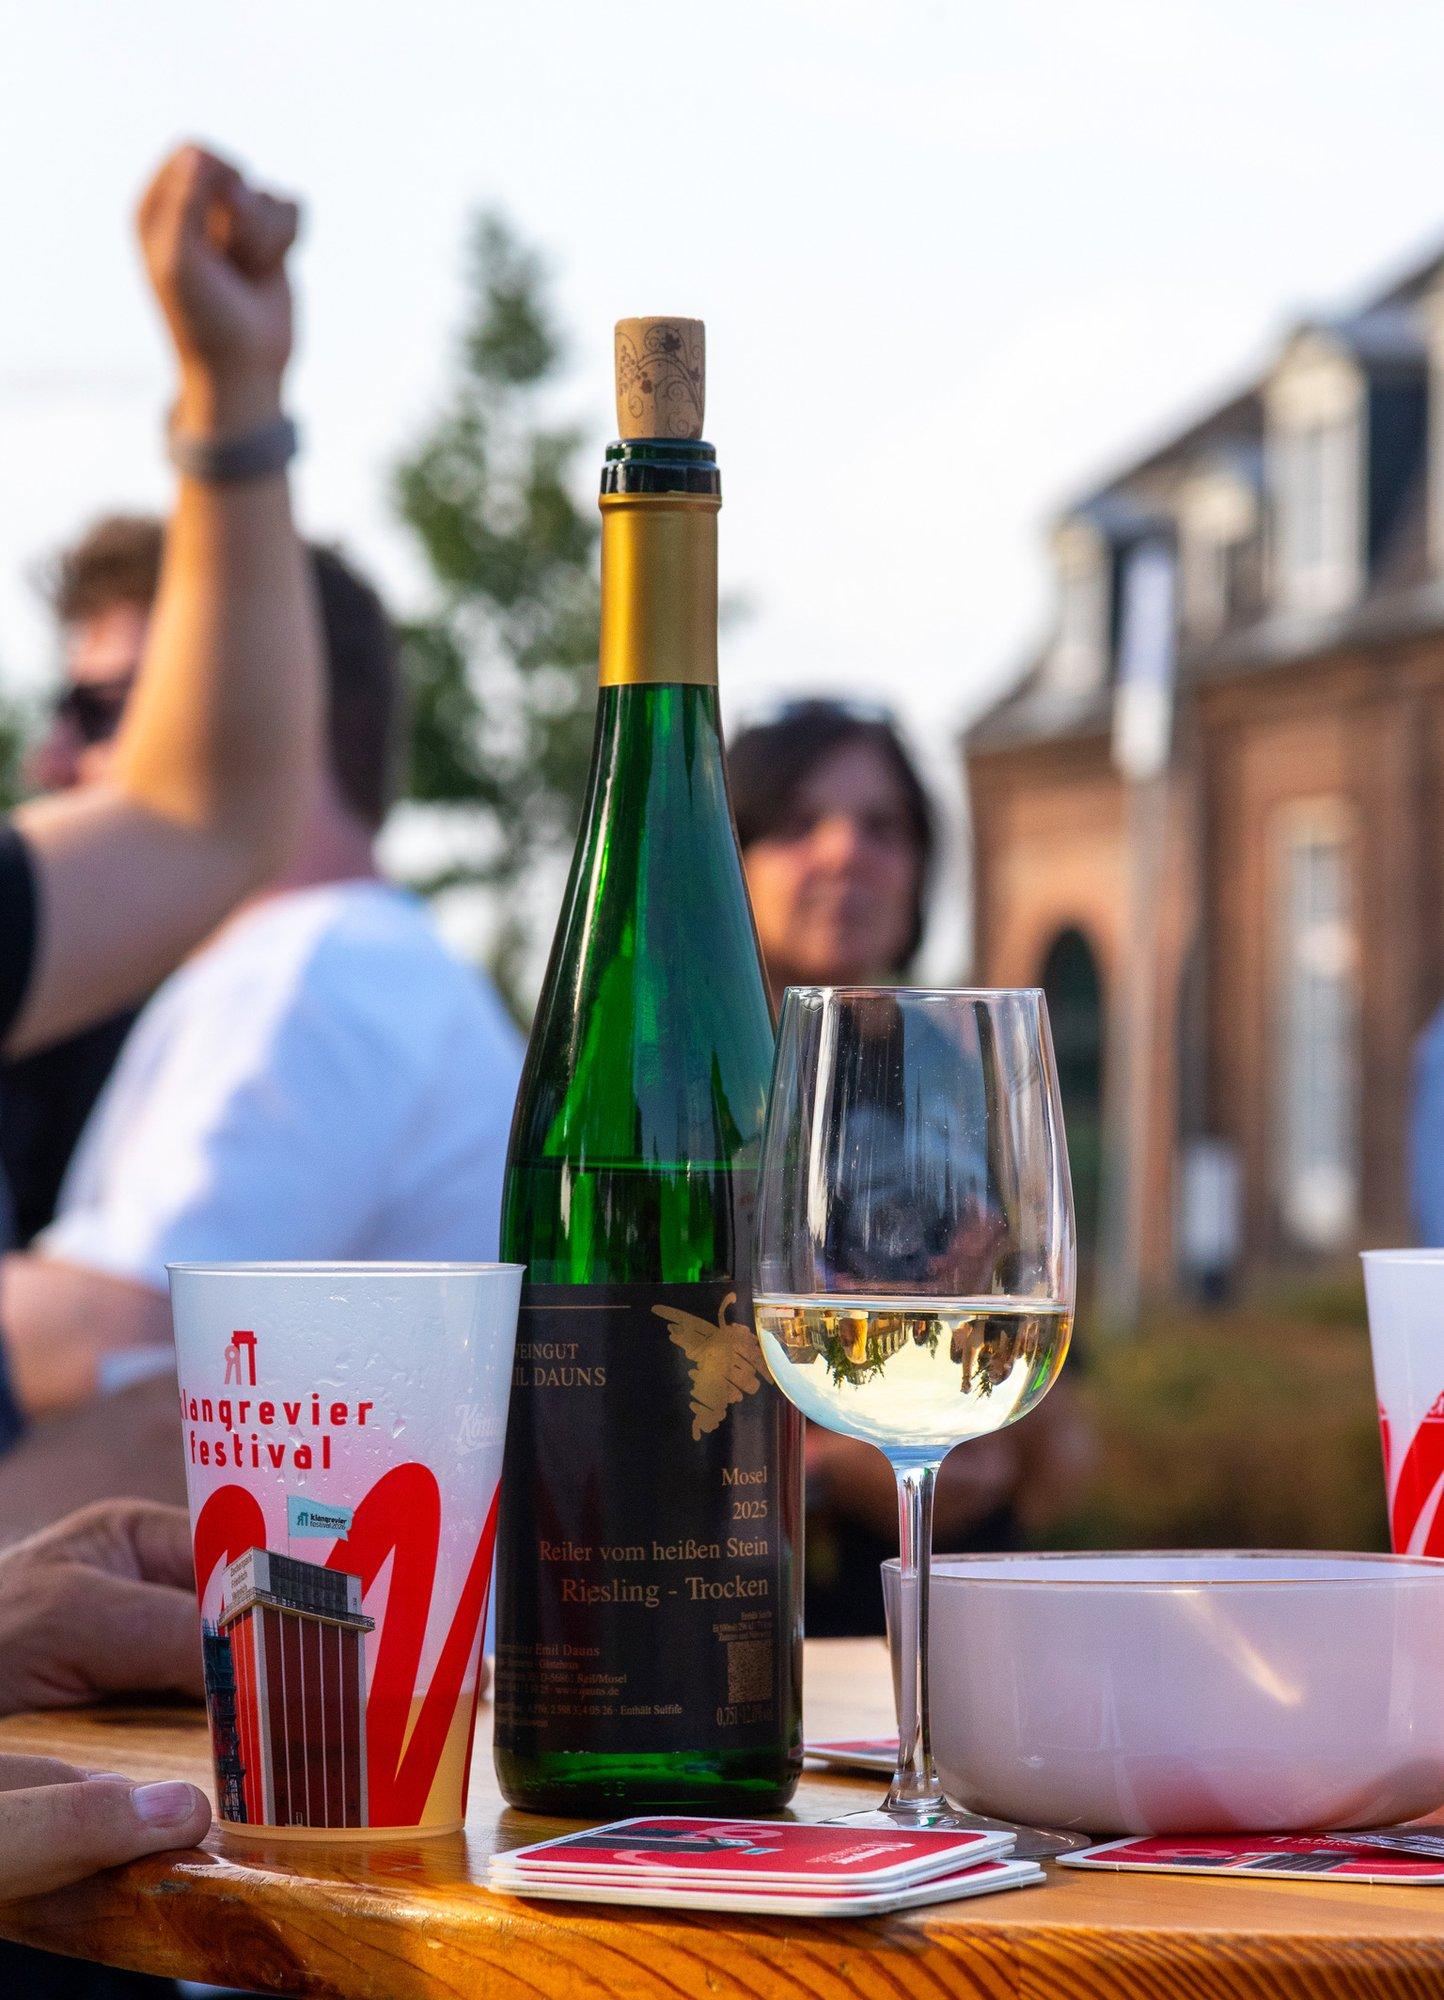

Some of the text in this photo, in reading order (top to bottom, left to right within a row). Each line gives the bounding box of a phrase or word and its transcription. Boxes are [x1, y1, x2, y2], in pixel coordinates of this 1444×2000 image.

[533, 1366, 607, 1388] DAUNS
[182, 1388, 375, 1432] langrevier
[190, 1430, 331, 1470] festival
[721, 1465, 769, 1487] Mosel
[732, 1500, 769, 1521] 2025
[539, 1537, 769, 1562] Reiler vom heißen Stein
[561, 1577, 660, 1608] Riesling
[685, 1575, 769, 1601] Trocken
[536, 1643, 560, 1656] Emil
[563, 1643, 601, 1656] Dauns
